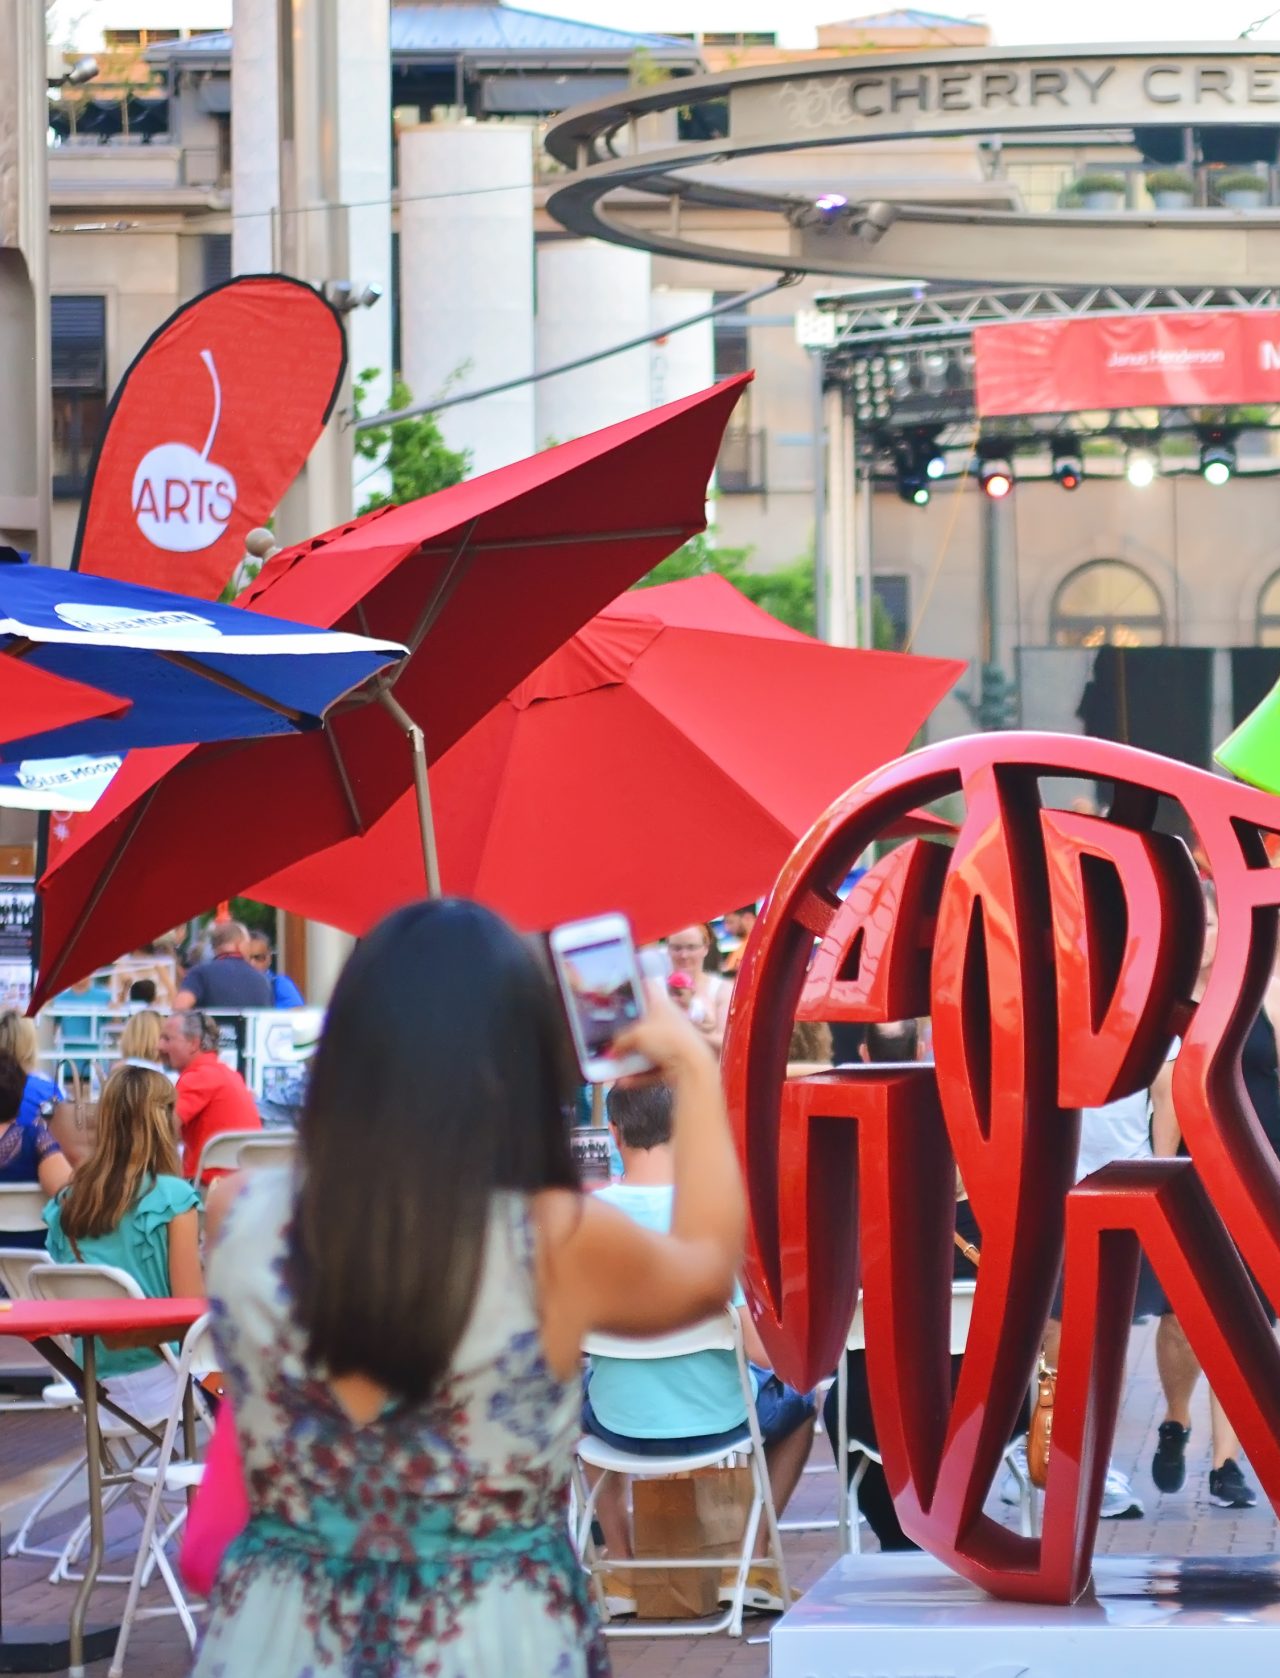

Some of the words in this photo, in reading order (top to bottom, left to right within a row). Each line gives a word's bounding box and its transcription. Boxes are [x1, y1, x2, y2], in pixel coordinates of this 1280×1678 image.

[848, 64, 1117, 117] CHERRY
[135, 478, 234, 523] ARTS
[70, 760, 119, 780] MOON
